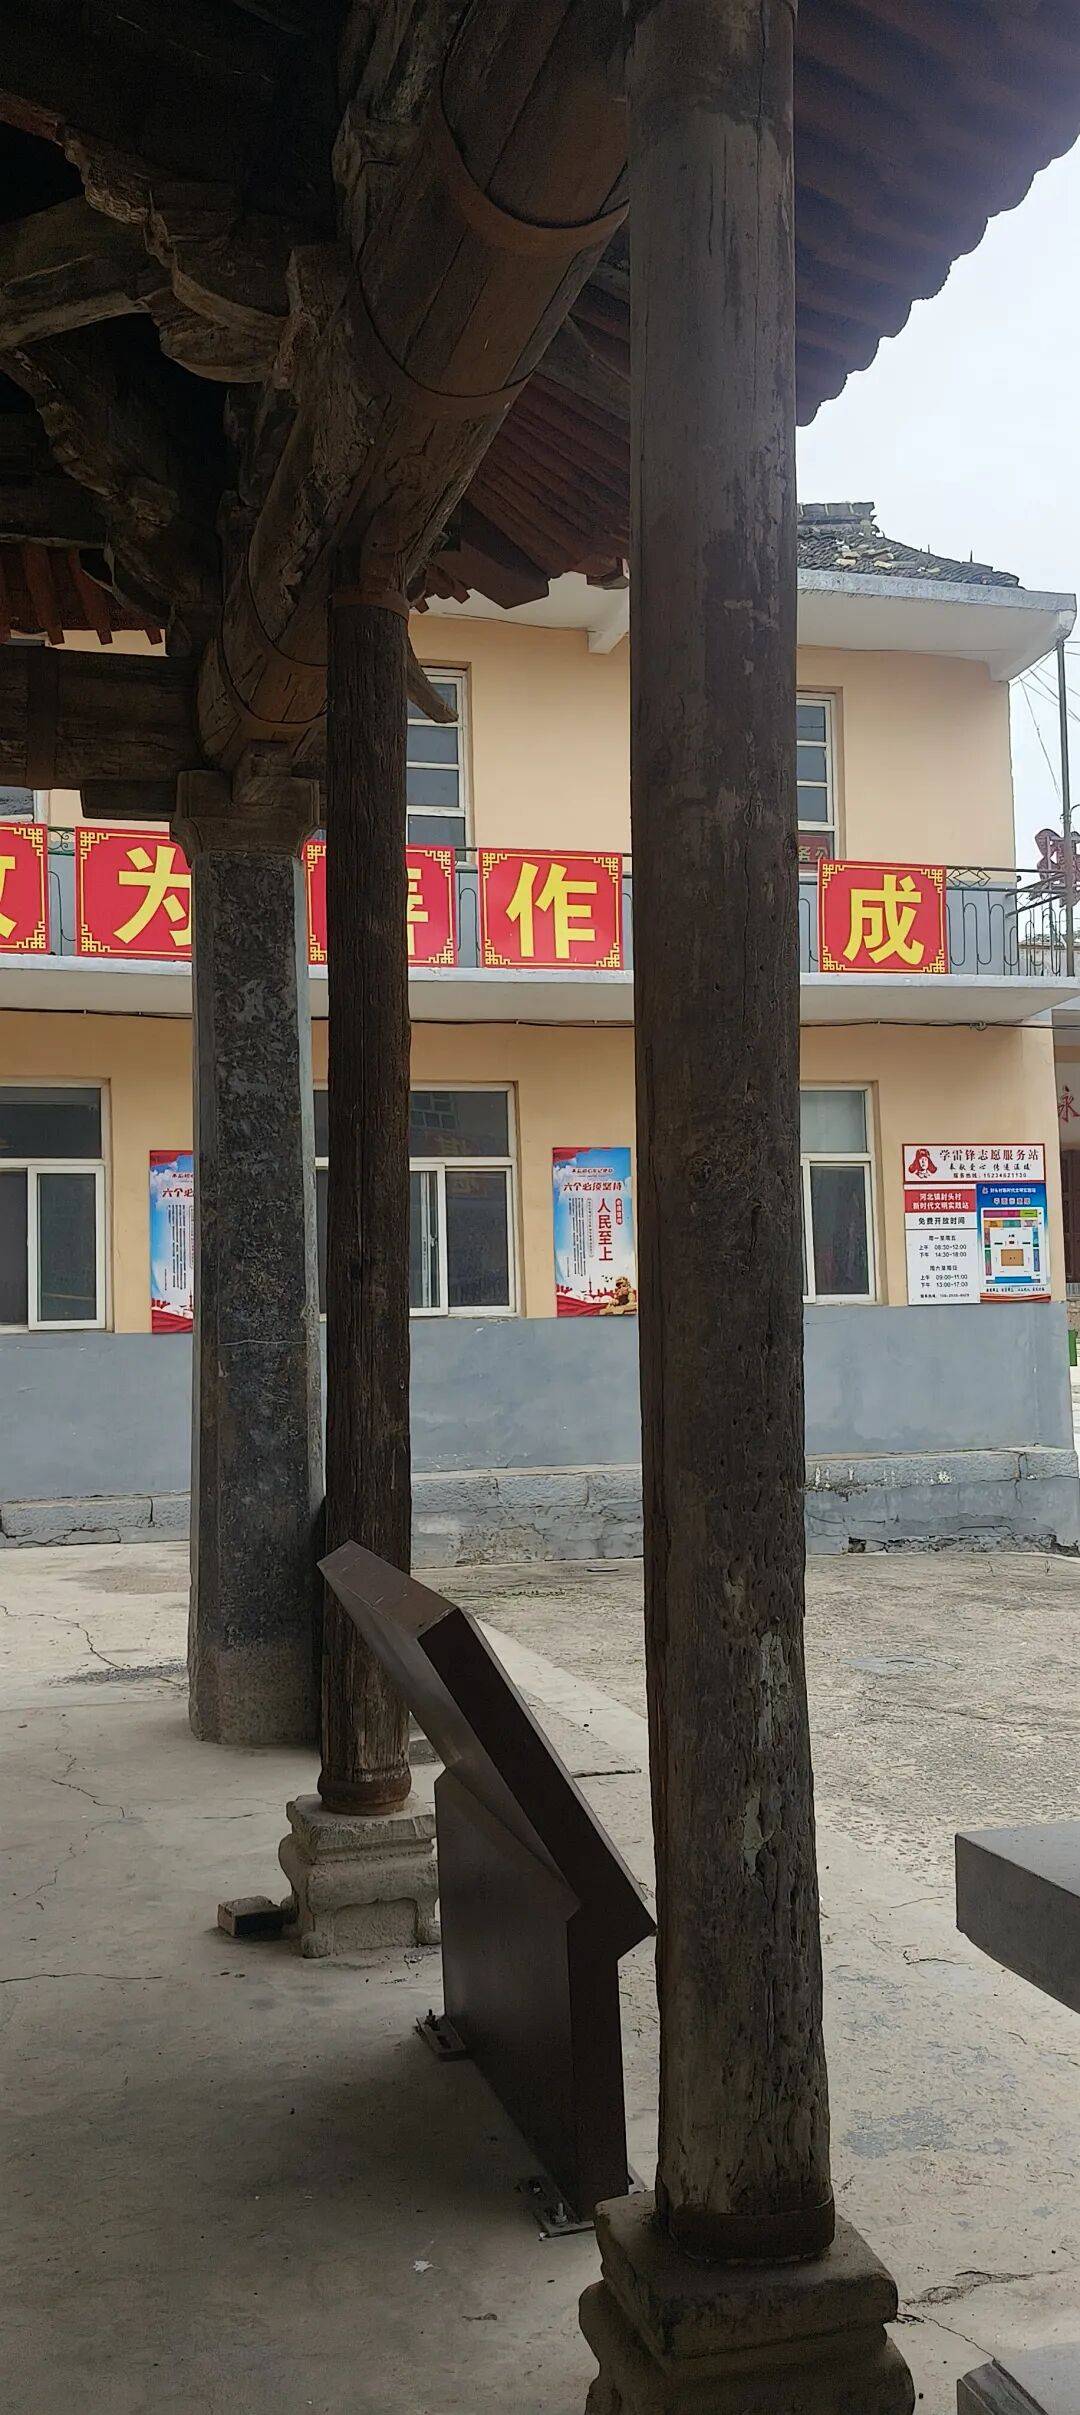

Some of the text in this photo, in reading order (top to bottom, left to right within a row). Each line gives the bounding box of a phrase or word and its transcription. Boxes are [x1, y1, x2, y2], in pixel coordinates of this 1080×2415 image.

[114, 845, 192, 948] 为
[505, 860, 599, 960] 作
[842, 873, 924, 965] 成
[939, 1148, 1039, 1161] 学雷锋志愿服务站
[563, 1182, 622, 1192] 六个必须坚持
[919, 1193, 962, 1201] 河北镇封头村
[913, 1202, 969, 1210] 新时代文明实践站
[918, 1217, 965, 1225] 免费开放时间
[597, 1197, 613, 1261] 人民至上
